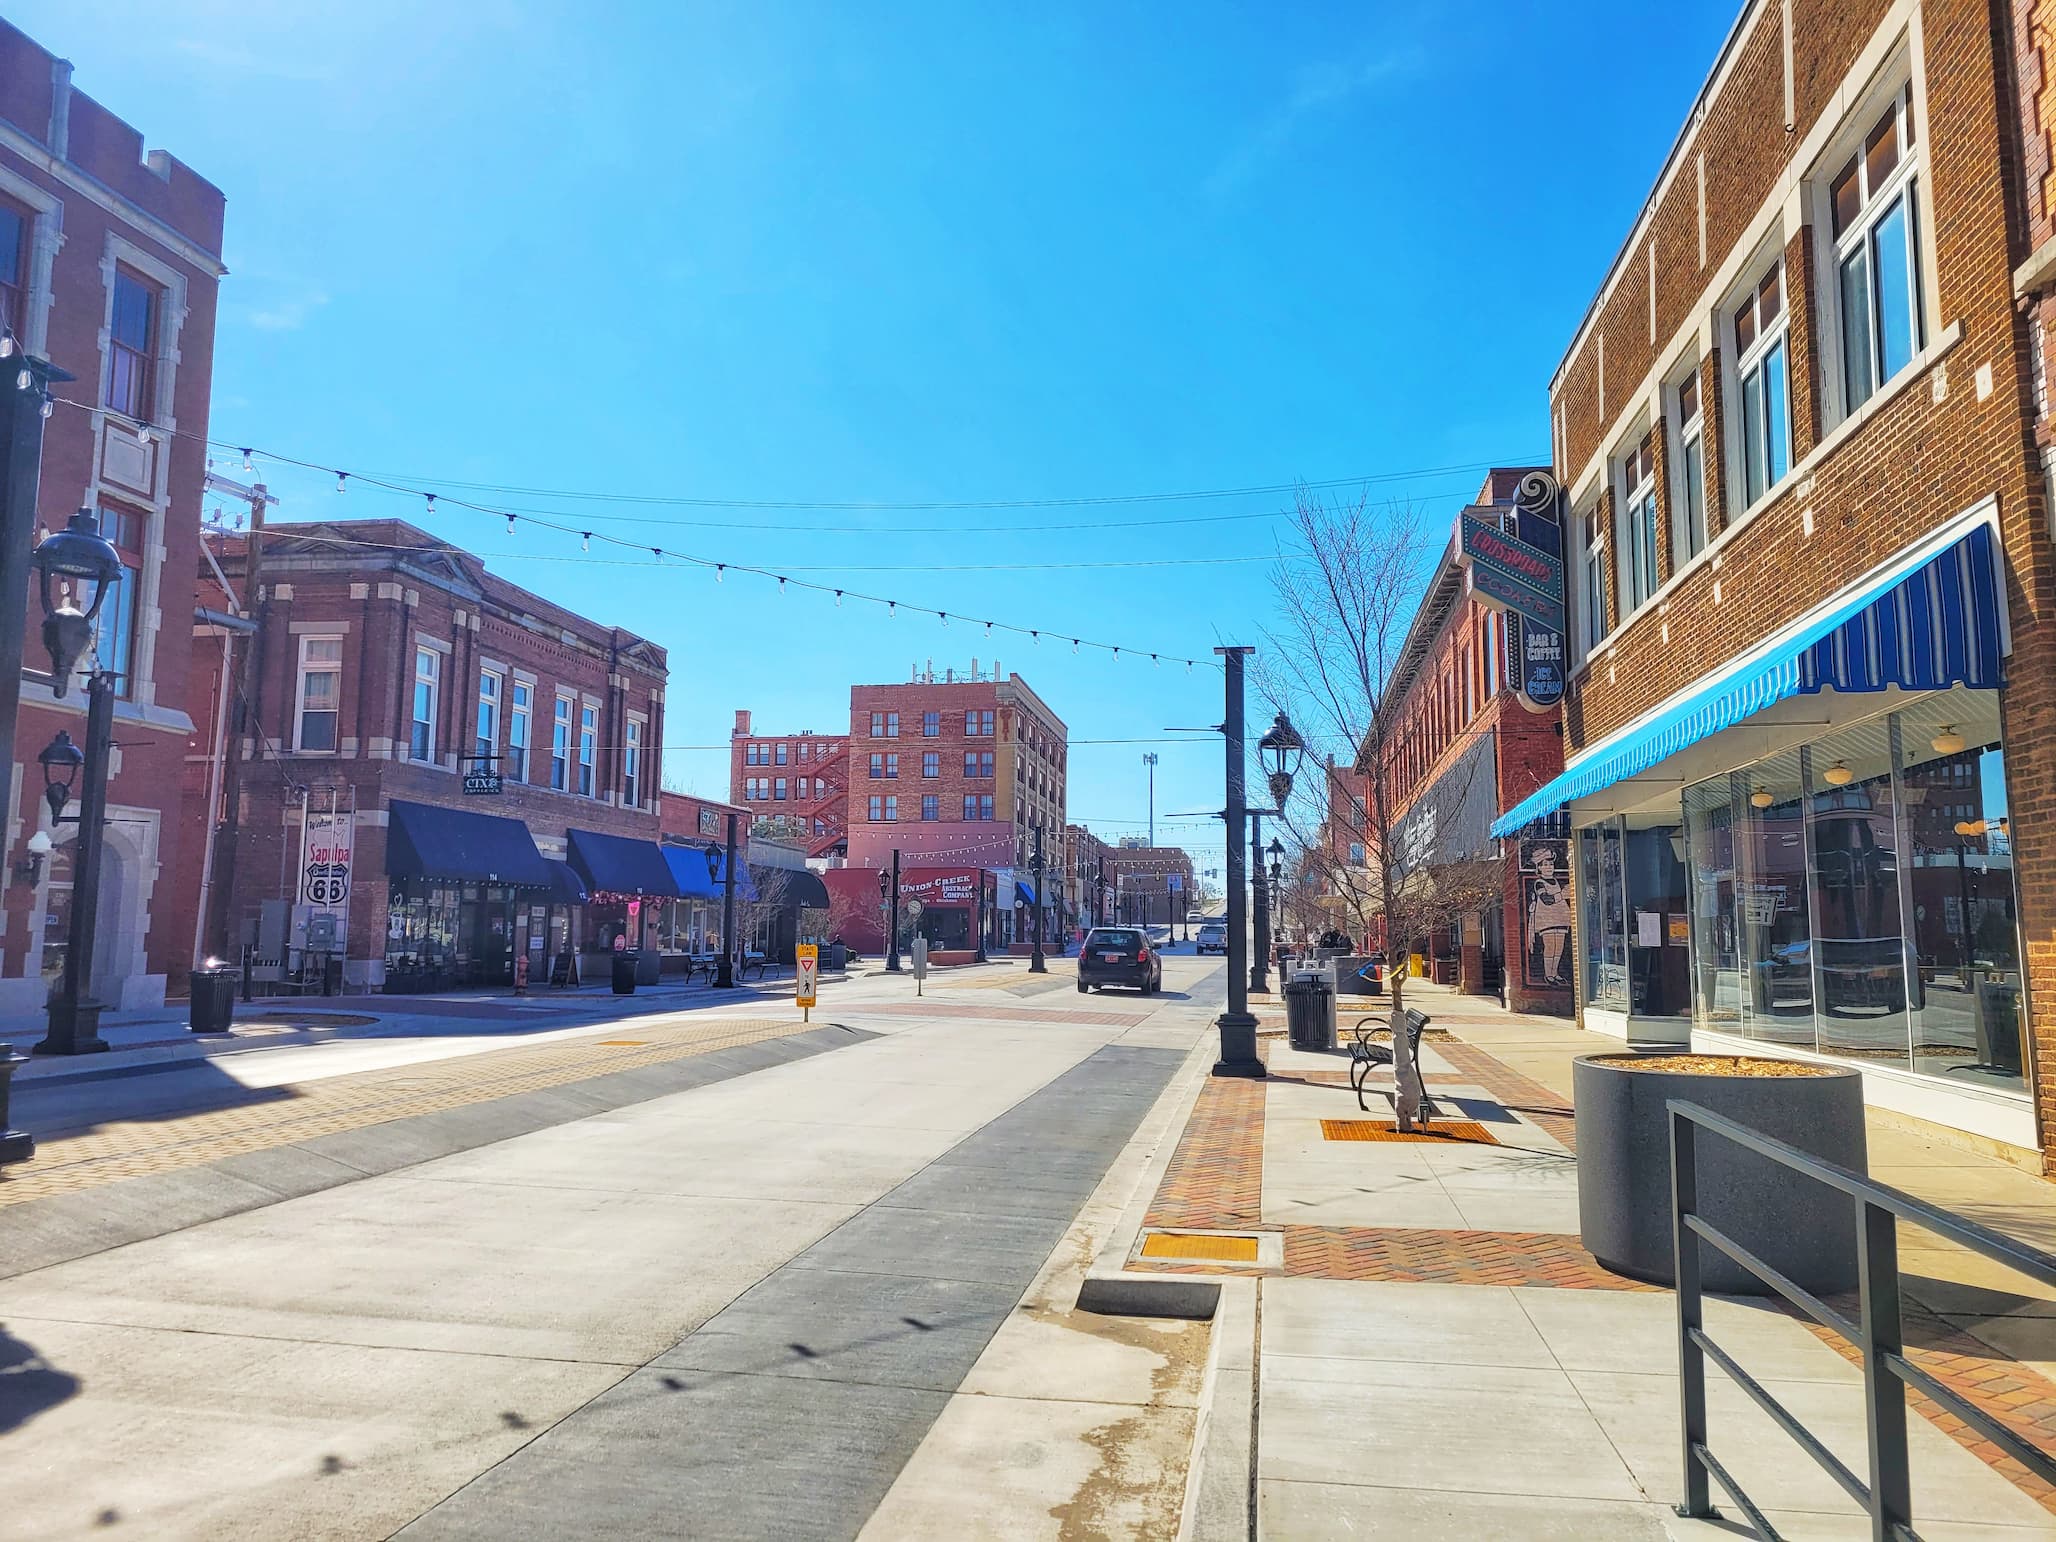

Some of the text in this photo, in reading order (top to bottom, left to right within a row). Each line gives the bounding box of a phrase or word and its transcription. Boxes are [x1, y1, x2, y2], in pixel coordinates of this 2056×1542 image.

[1471, 530, 1553, 583] CROSSROADS
[1528, 633, 1549, 648] BAR
[1527, 646, 1562, 661] COFFEE
[1535, 666, 1553, 681] ICE
[1527, 680, 1563, 696] CREAM
[466, 778, 488, 789] CTX
[310, 842, 350, 864] Sapulpa
[313, 879, 341, 900] 66
